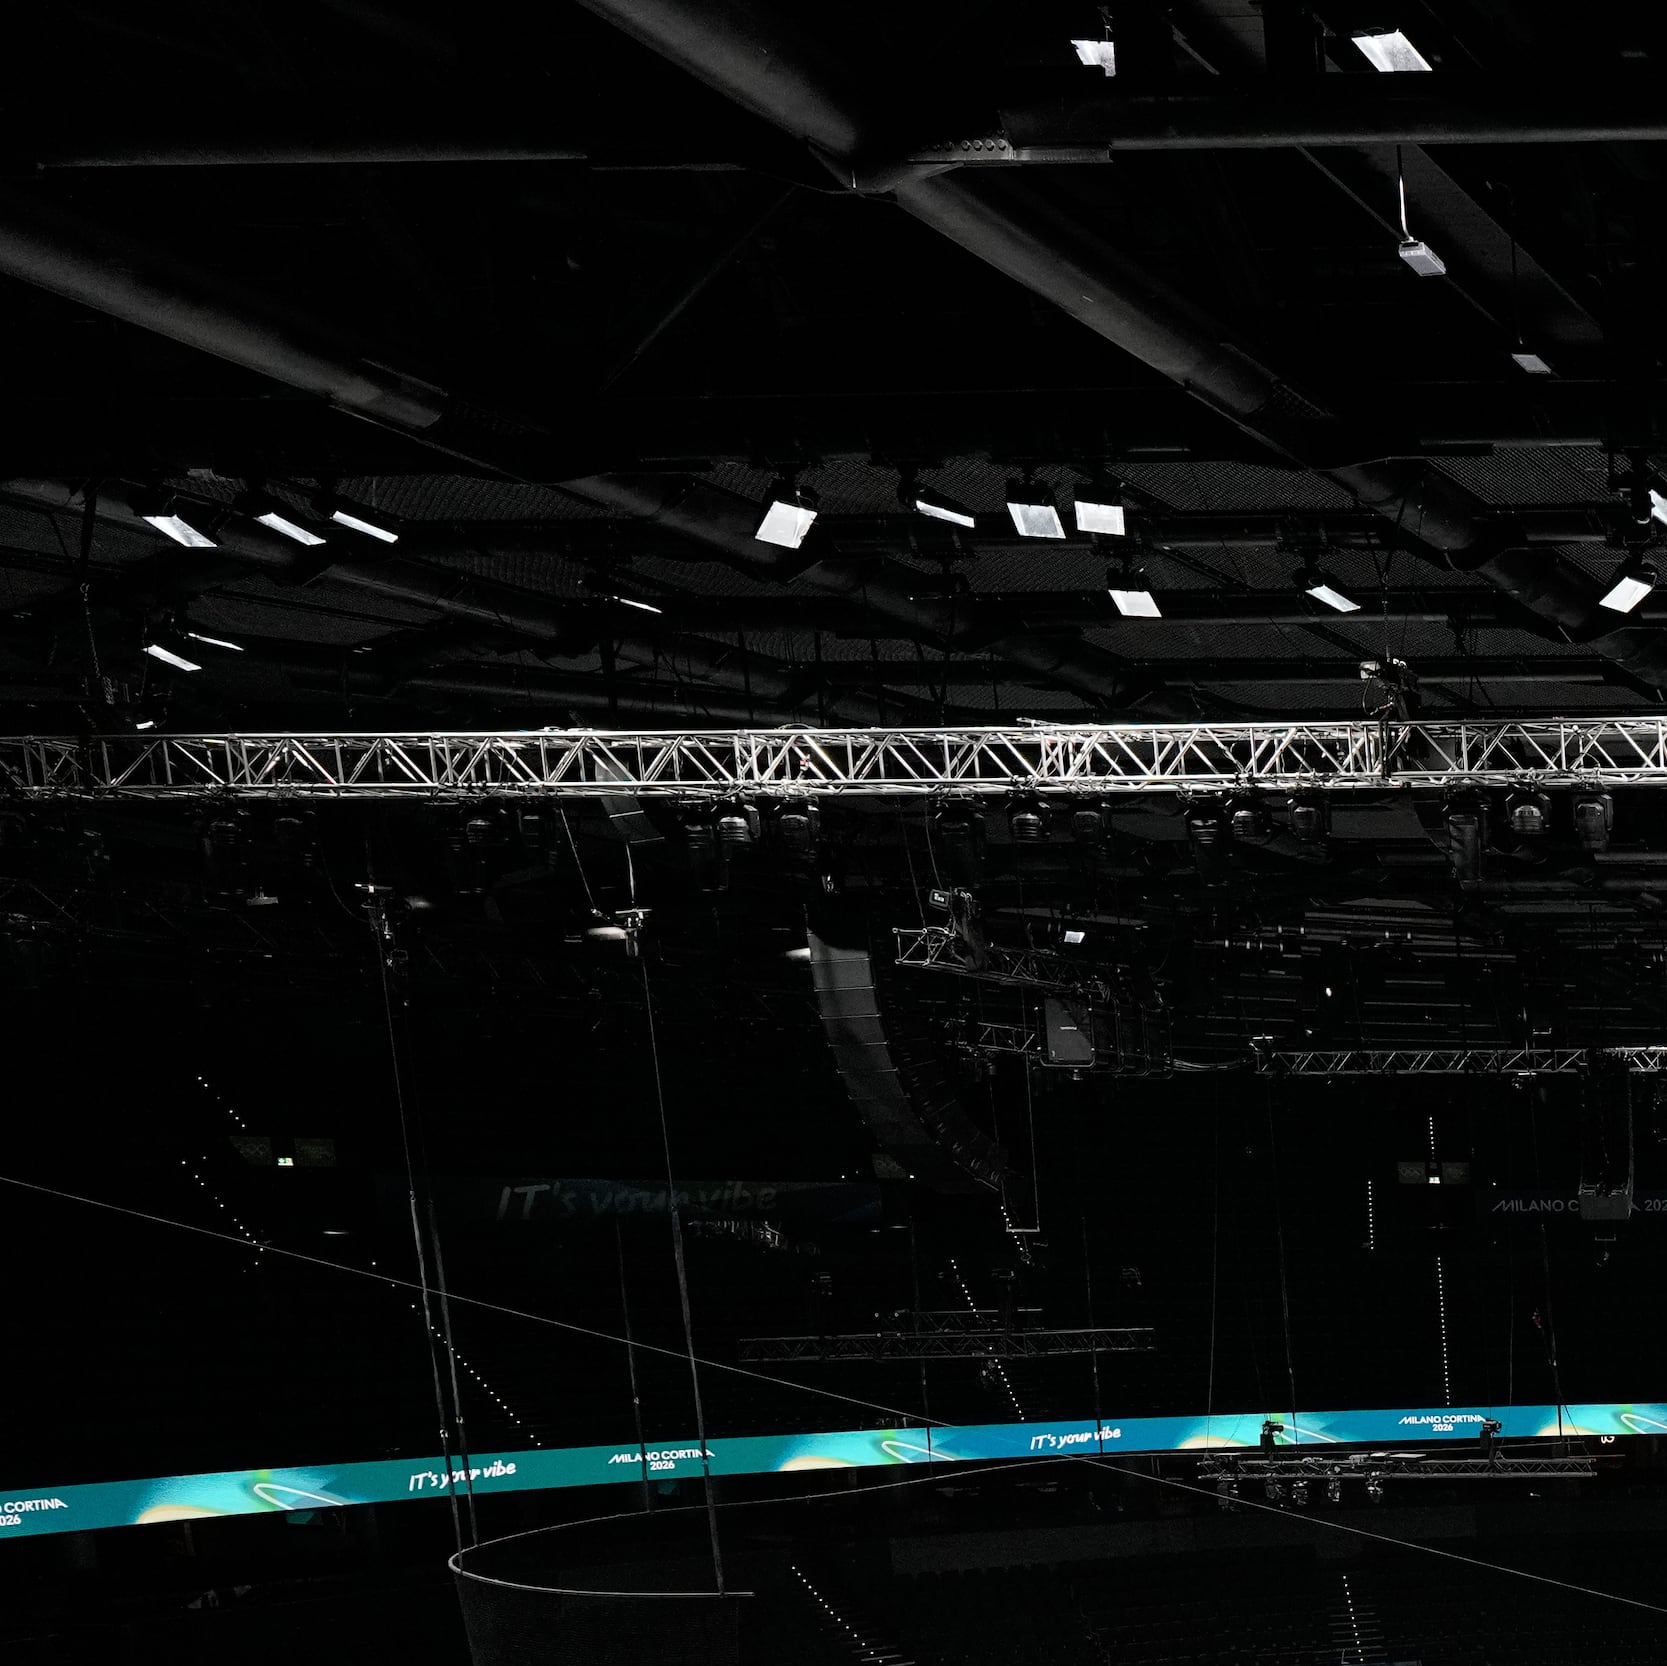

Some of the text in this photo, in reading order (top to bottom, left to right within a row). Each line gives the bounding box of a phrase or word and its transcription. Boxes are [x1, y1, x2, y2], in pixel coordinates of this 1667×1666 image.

[1398, 1414, 1486, 1425] MILANO CORTINA
[1432, 1423, 1454, 1432] 2026
[1030, 1425, 1122, 1451] IT's your vibe
[608, 1449, 716, 1465] MILANO CORTINA
[649, 1460, 676, 1471] 2026
[409, 1471, 439, 1492] IT's
[483, 1460, 517, 1479] vibe
[4, 1498, 69, 1514] CORTINA
